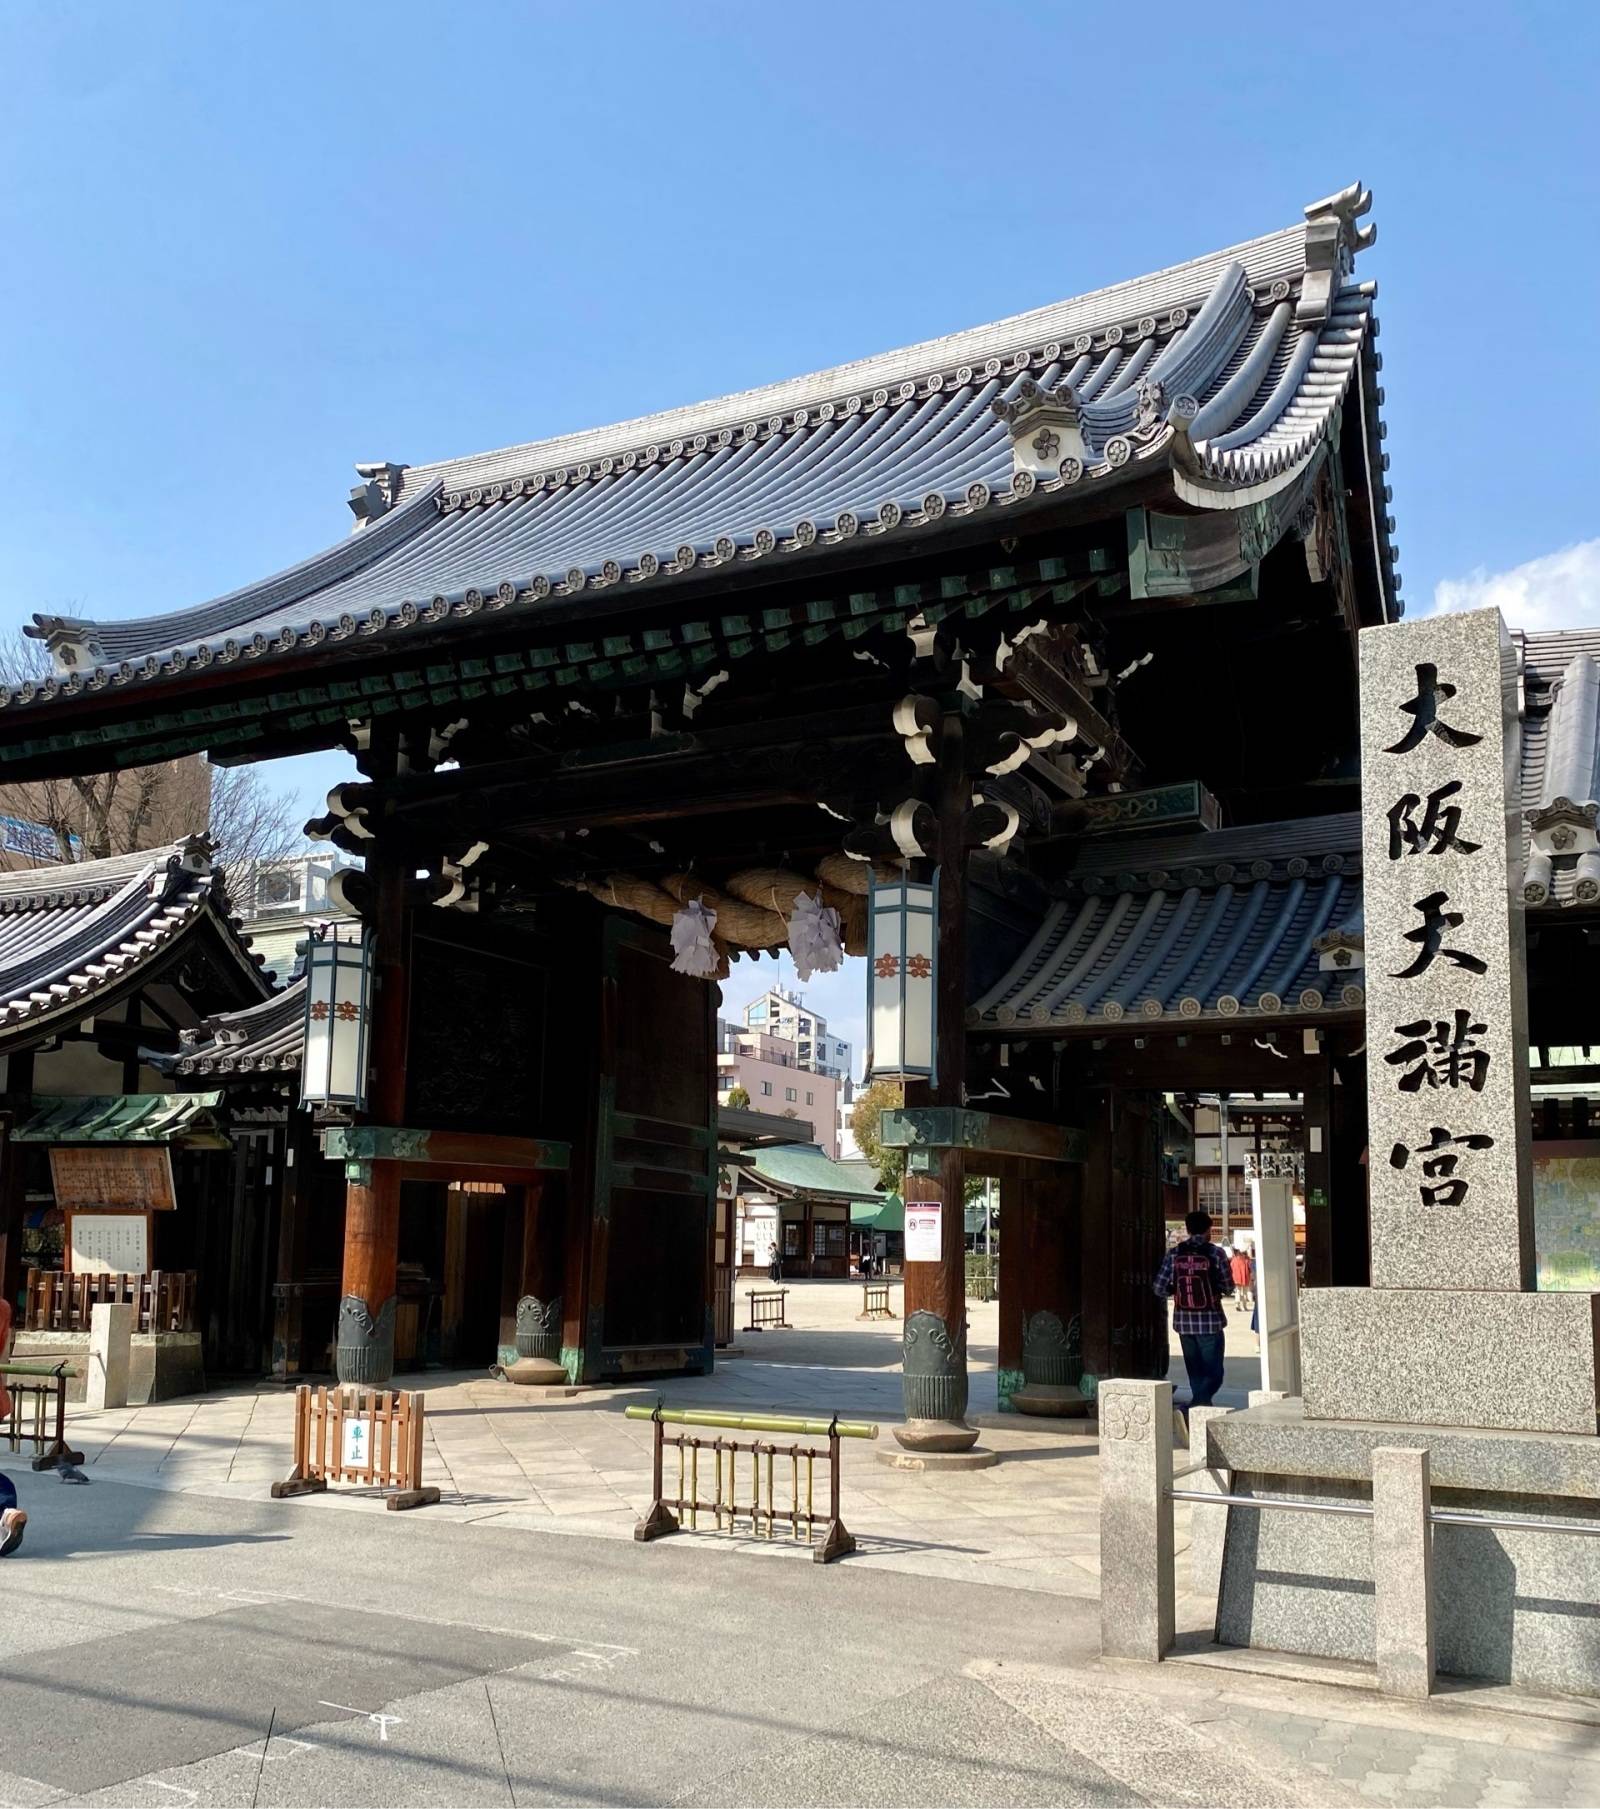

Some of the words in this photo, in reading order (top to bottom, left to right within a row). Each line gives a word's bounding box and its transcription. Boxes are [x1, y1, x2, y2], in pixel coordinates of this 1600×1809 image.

[1382, 663, 1494, 1206] 大阪天満宮
[351, 1425, 363, 1460] 車止
